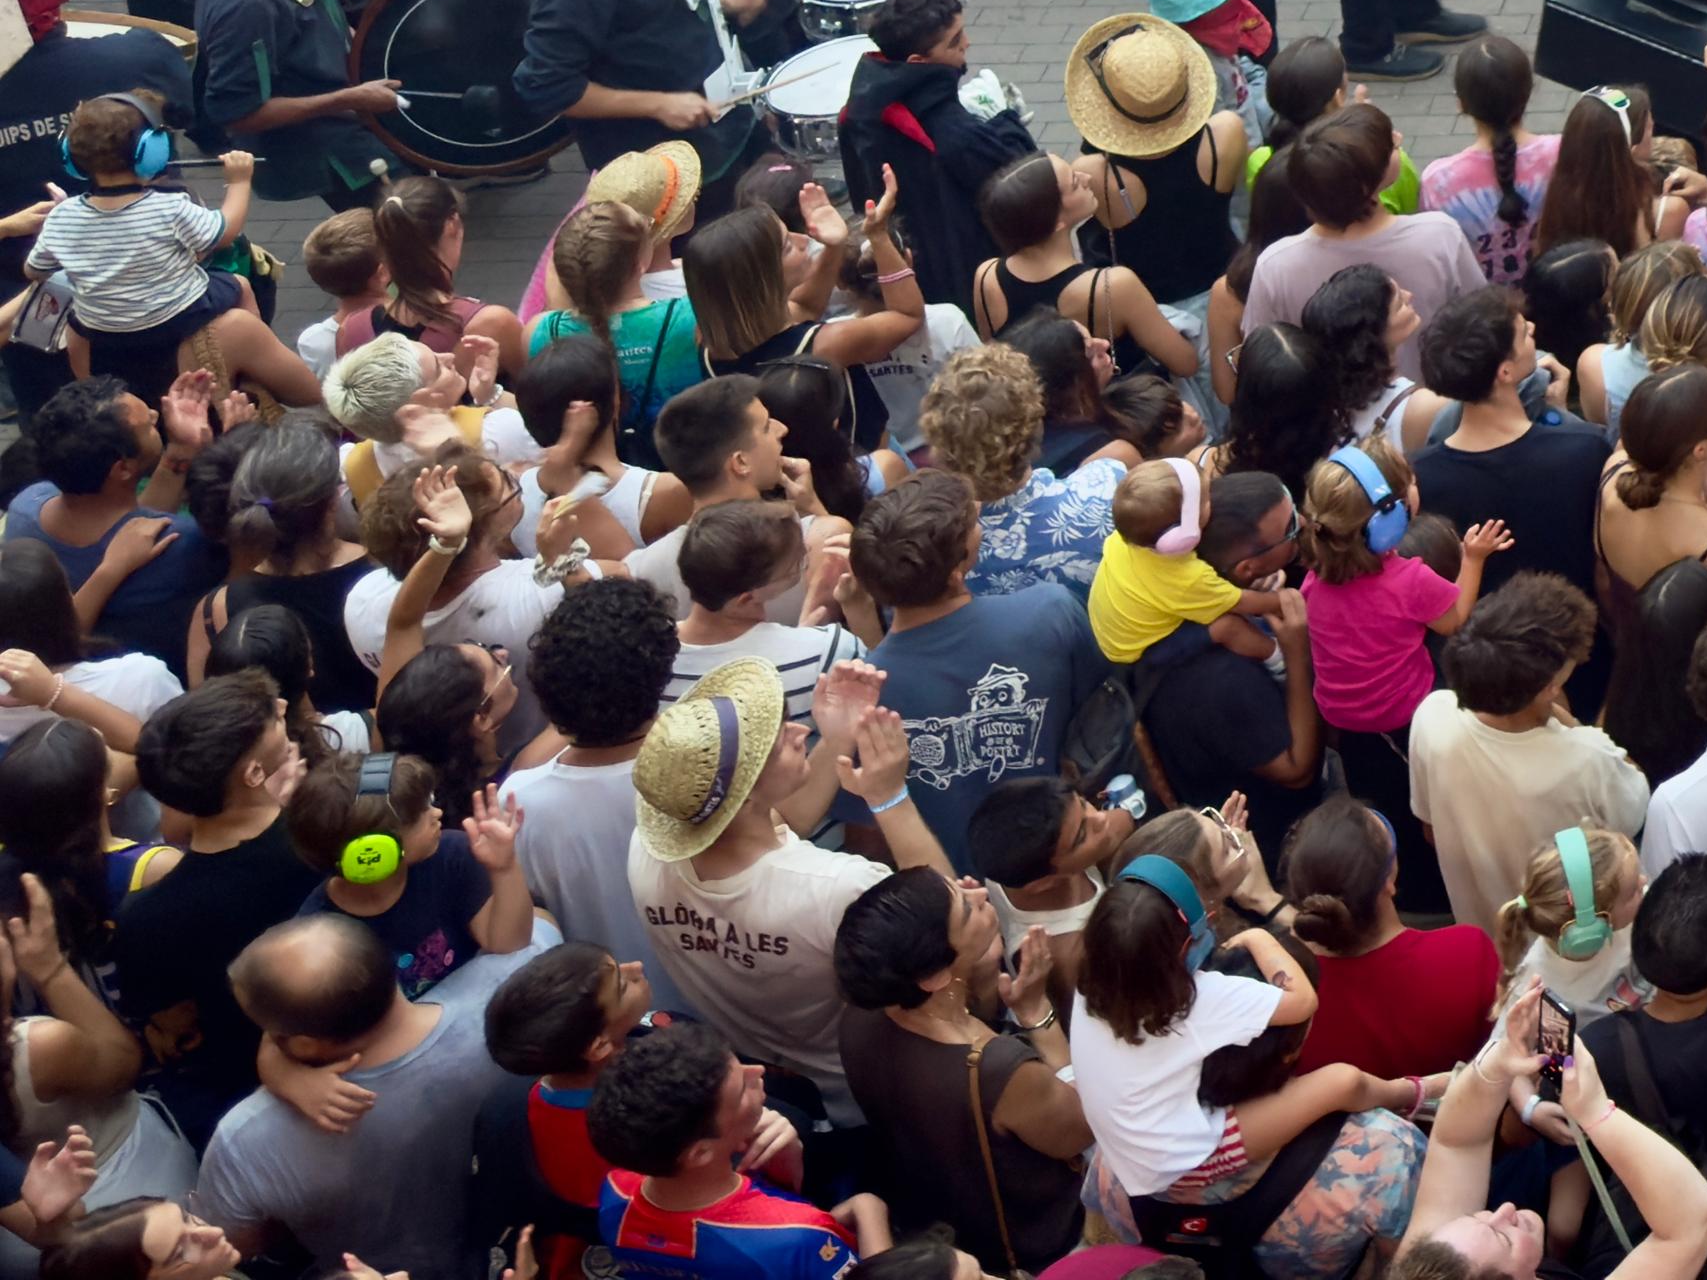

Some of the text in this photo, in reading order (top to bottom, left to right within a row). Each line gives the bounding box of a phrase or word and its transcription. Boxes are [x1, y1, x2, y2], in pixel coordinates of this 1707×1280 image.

[33, 117, 57, 137] DE
[979, 721, 1026, 738] HISTORY
[725, 921, 739, 945] A
[746, 931, 789, 956] LES
